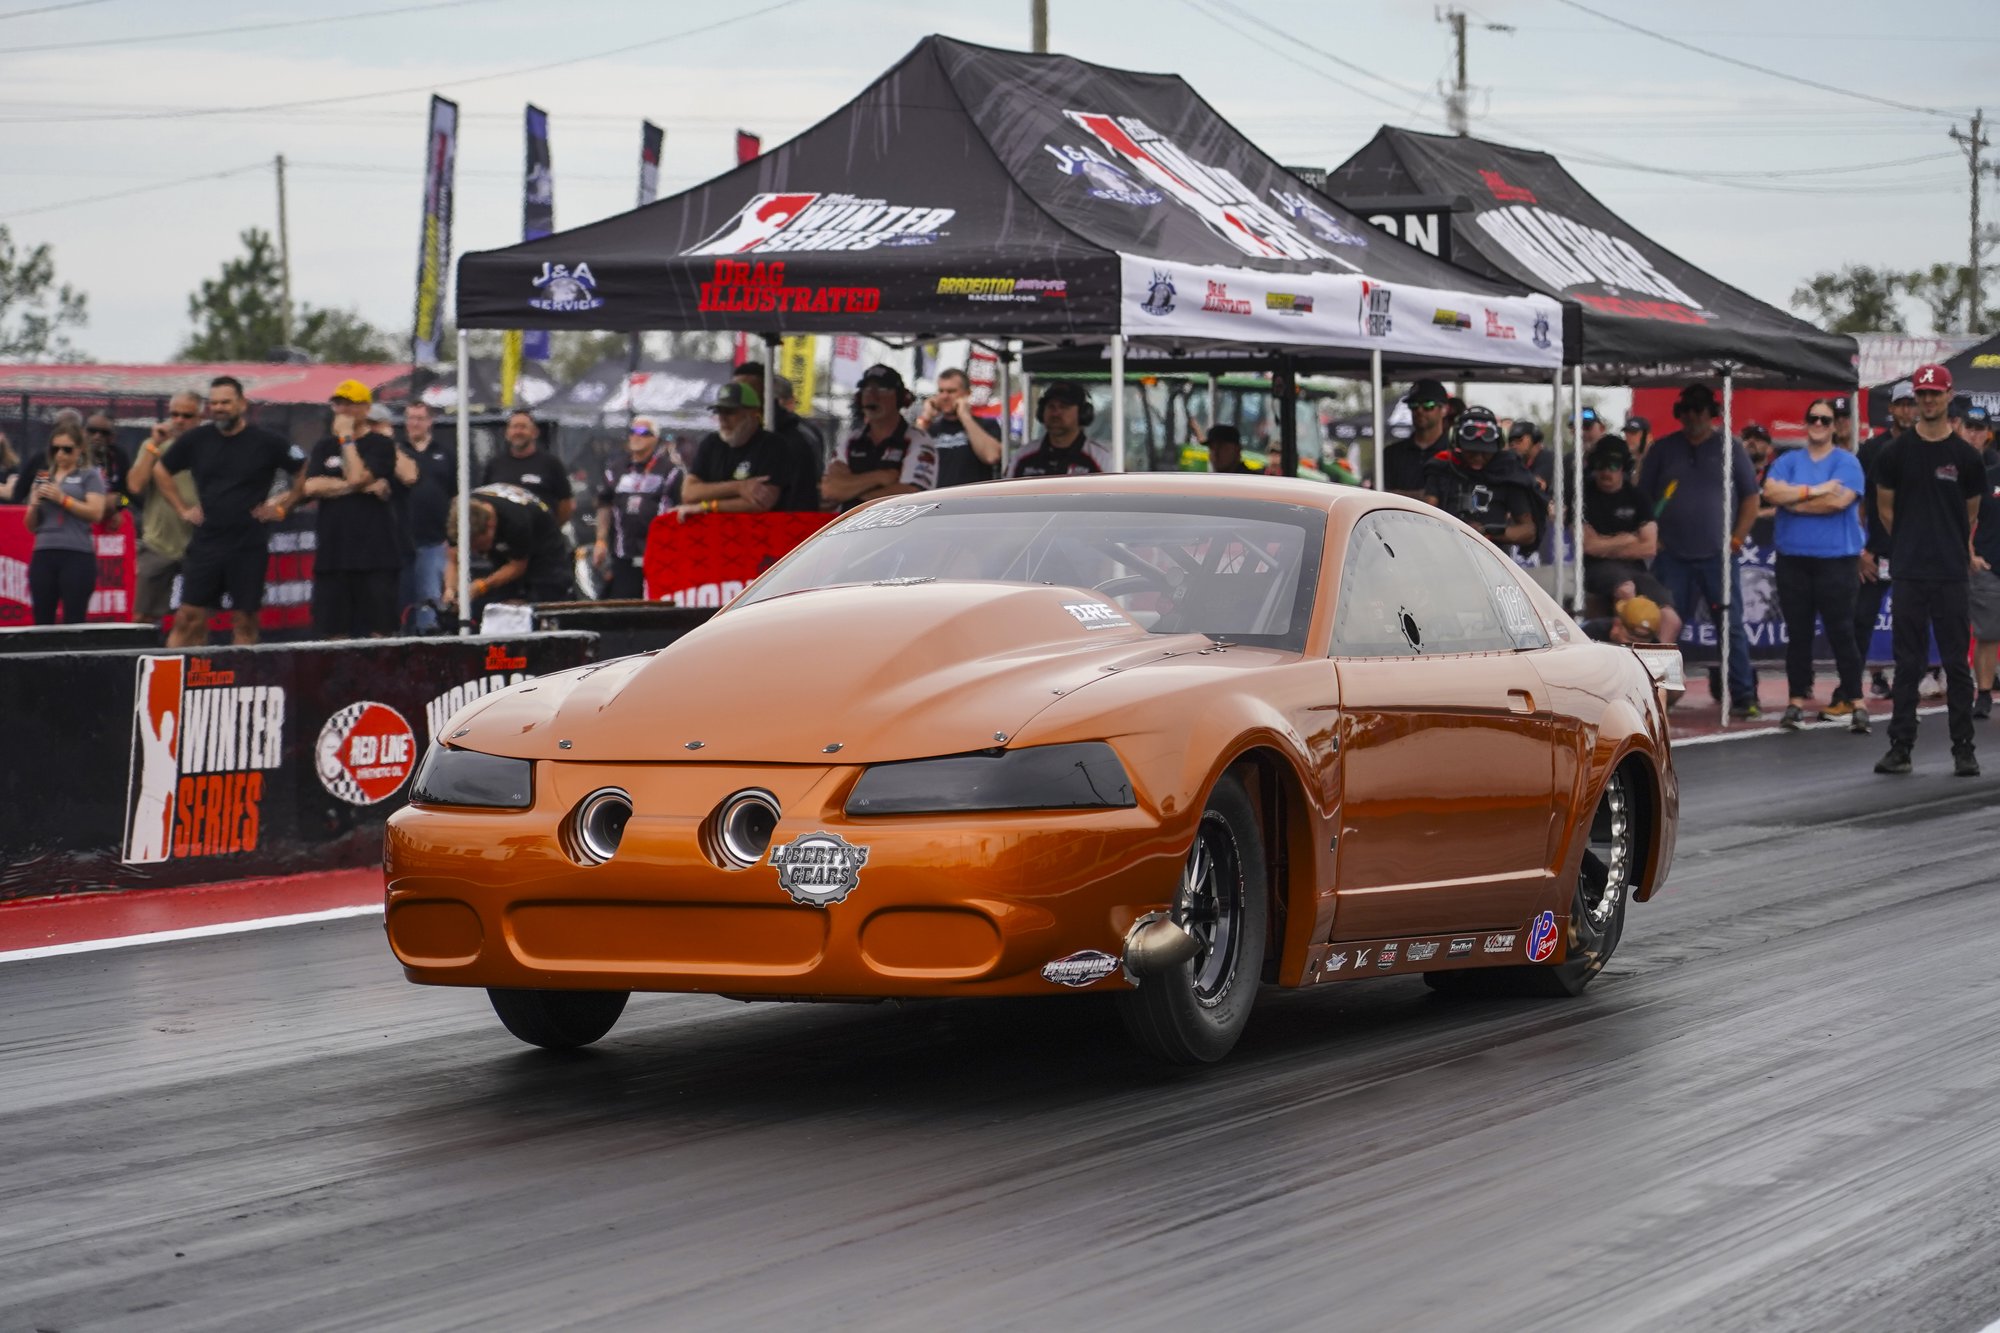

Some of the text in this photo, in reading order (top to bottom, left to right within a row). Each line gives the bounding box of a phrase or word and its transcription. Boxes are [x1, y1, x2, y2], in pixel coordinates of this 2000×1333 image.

[792, 204, 956, 233] WINTER
[752, 230, 896, 253] SERIES
[532, 261, 596, 287] J&A
[713, 259, 785, 287] DRAG
[936, 277, 1015, 294] BRADENTON
[530, 299, 601, 311] SERVICE
[698, 283, 880, 312] ILLUSTRATED
[182, 686, 285, 774] WINTER
[349, 733, 409, 766] RED LINE
[174, 771, 264, 858] SERIES
[769, 846, 869, 865] LIBERTY'S
[790, 866, 851, 885] GEARS
[1529, 911, 1553, 961] VP
